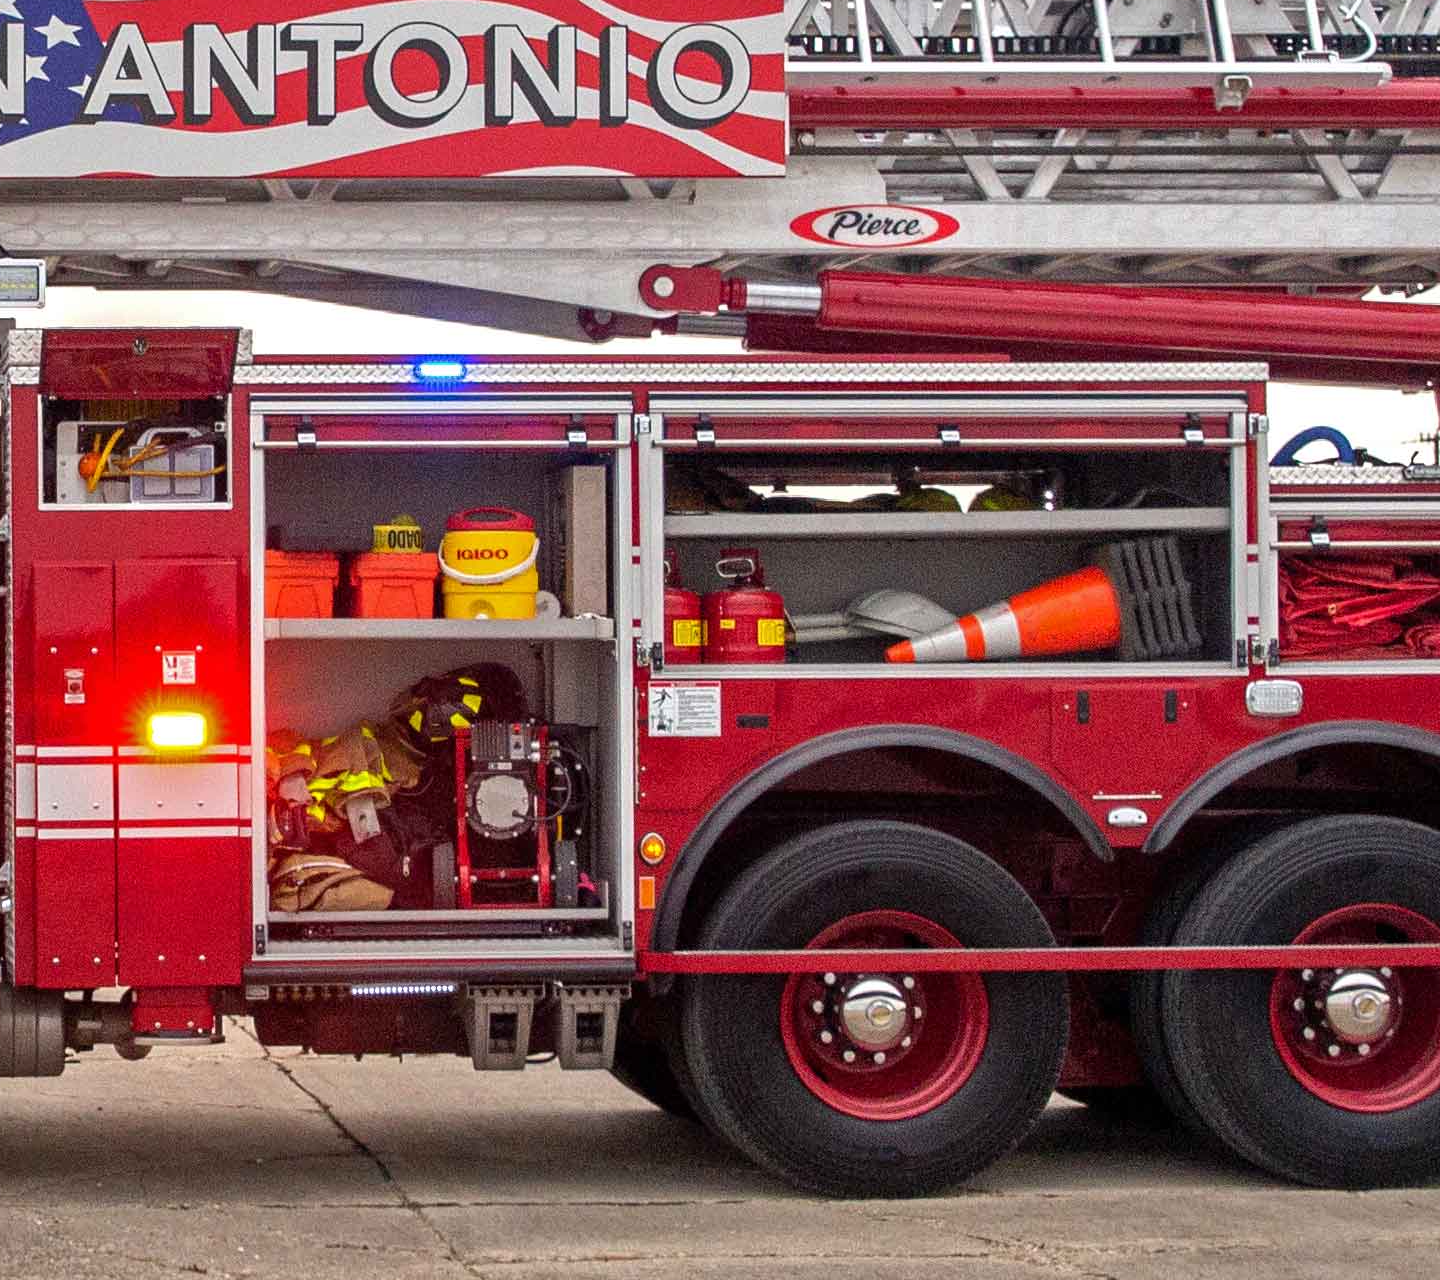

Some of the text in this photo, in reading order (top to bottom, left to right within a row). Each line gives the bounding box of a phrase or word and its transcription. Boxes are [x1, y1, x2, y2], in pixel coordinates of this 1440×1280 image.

[80, 21, 752, 130] ANTONIO
[827, 210, 921, 240] Pierce
[456, 548, 509, 561] IGLOO
